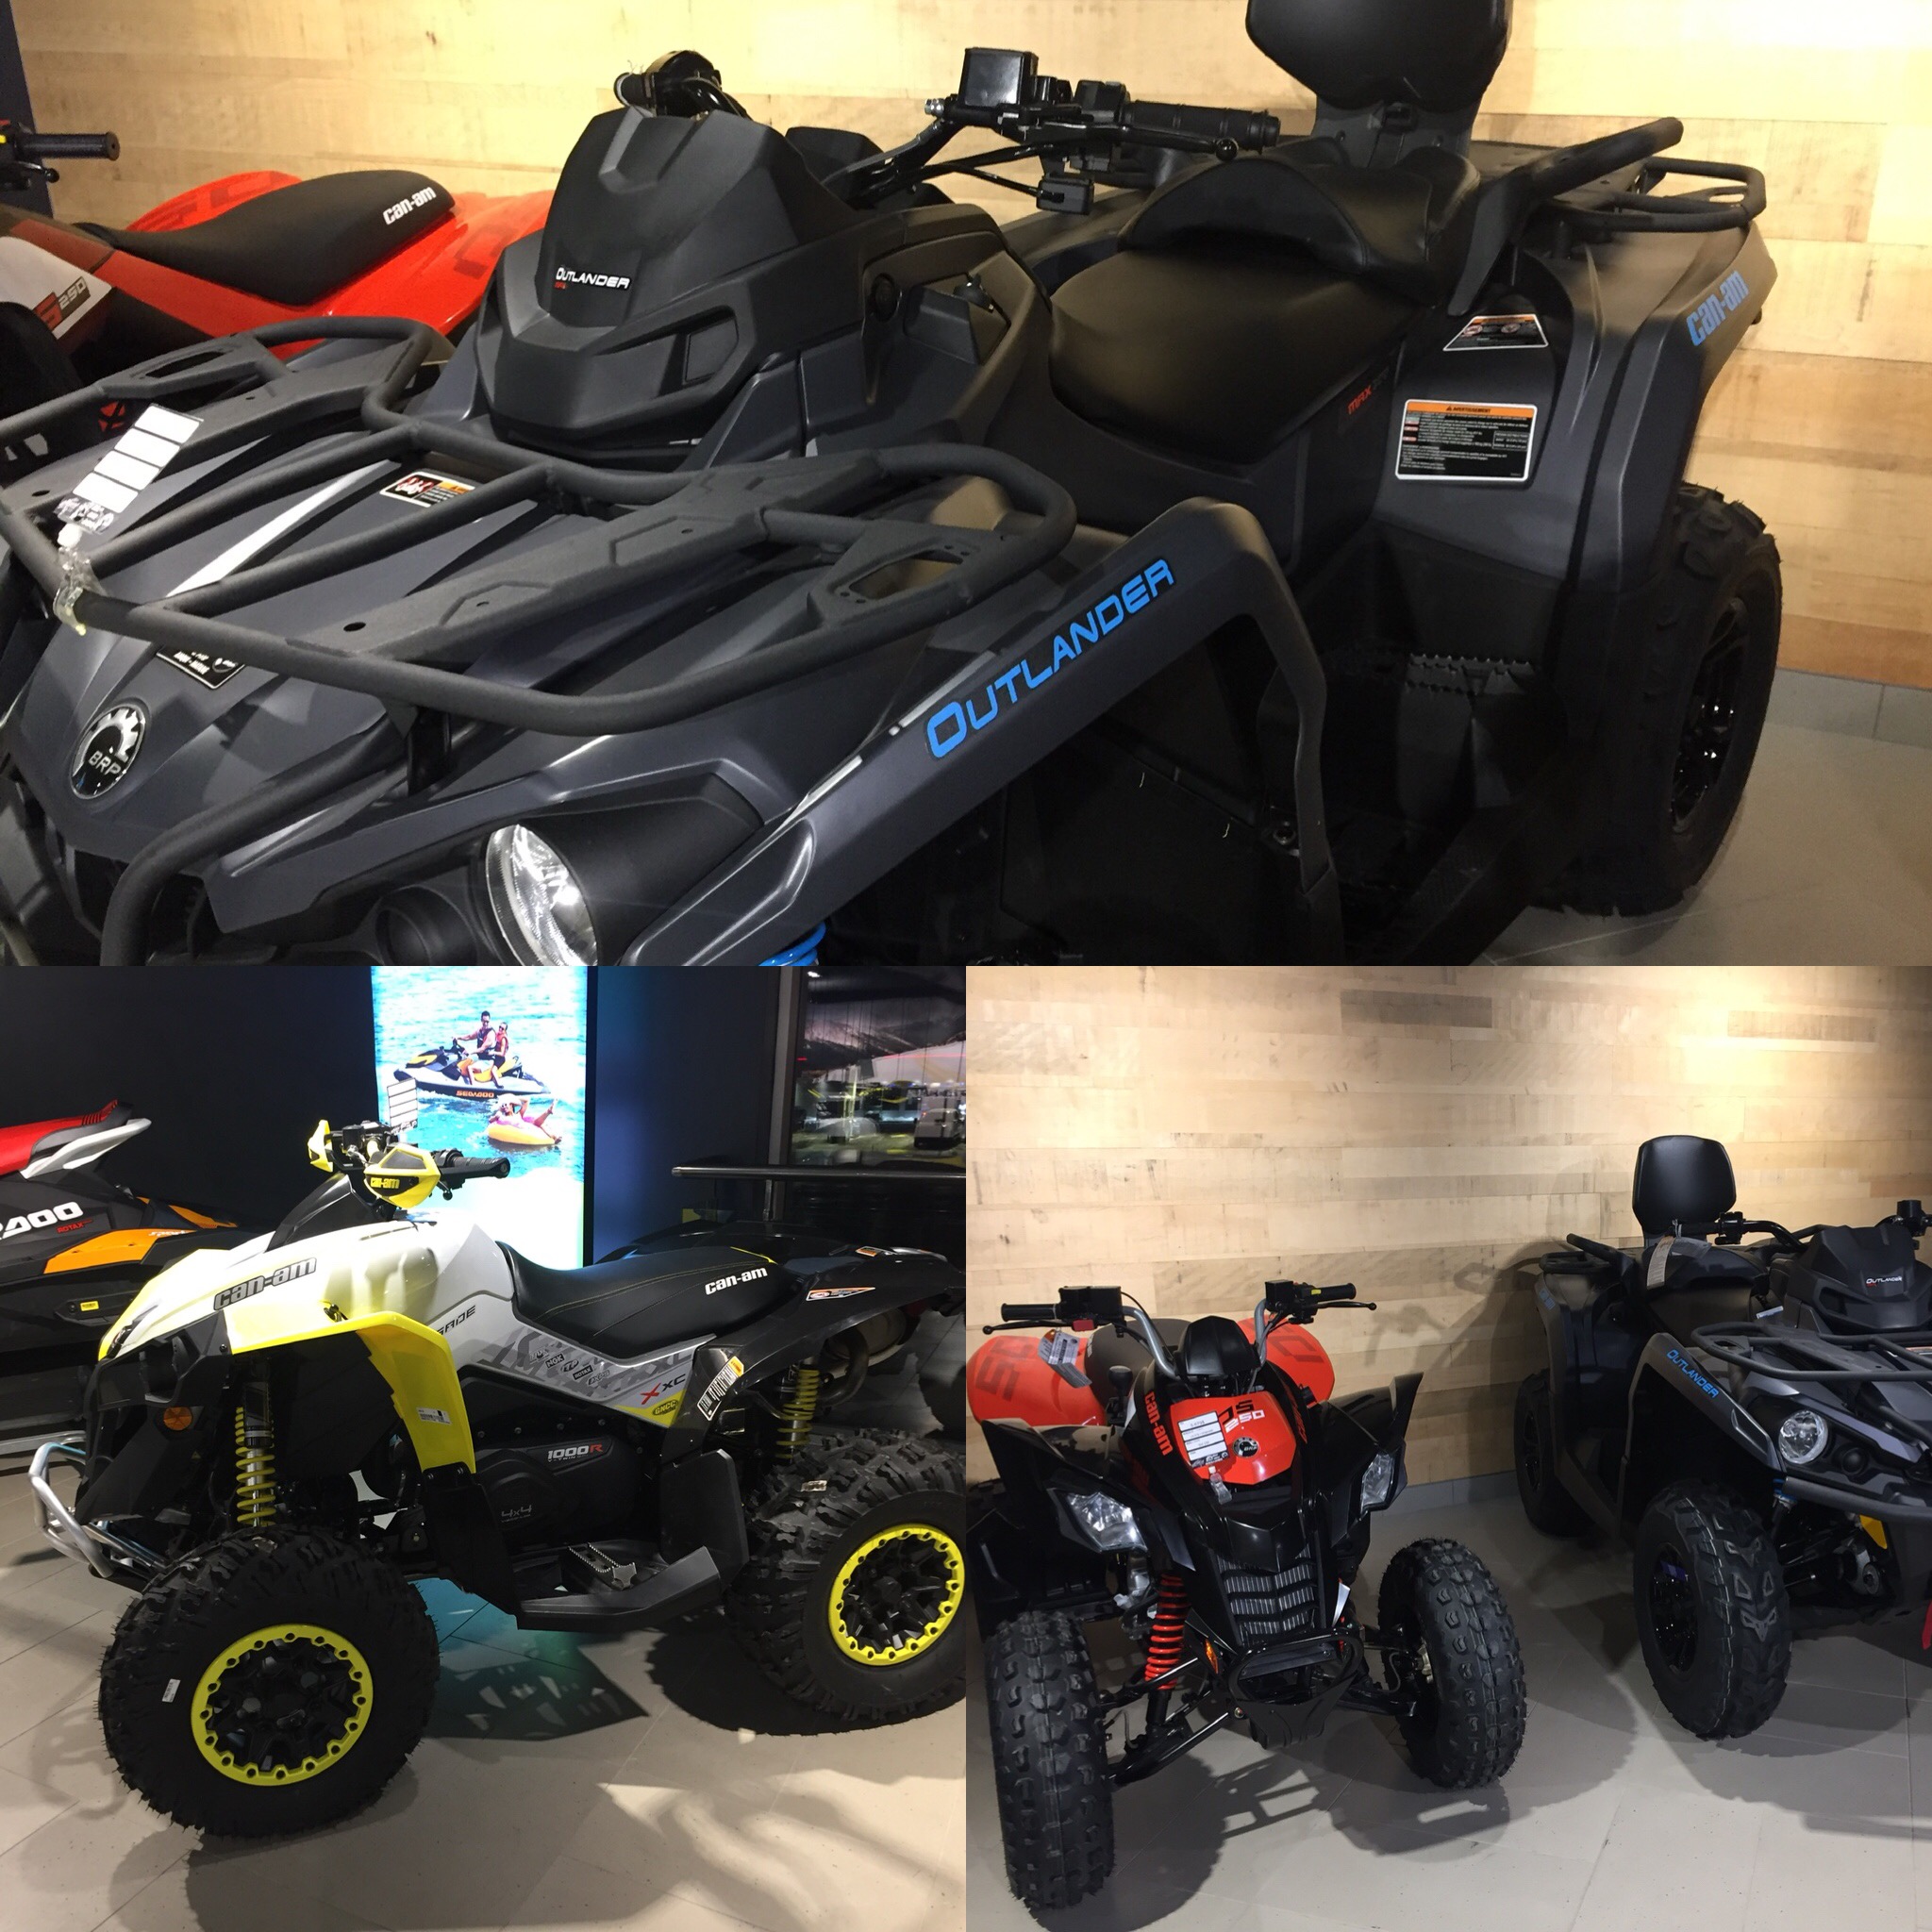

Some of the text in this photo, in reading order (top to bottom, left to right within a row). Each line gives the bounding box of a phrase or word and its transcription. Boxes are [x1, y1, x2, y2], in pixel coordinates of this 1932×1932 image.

[555, 266, 632, 291] OUTLANDER
[57, 275, 88, 311] 250
[926, 558, 1175, 758] OUTLANDER
[88, 750, 122, 776] BRP
[56, 1221, 85, 1233] ROTAX
[212, 1257, 318, 1311] can-am
[705, 1266, 769, 1296] can-am
[1865, 1275, 1903, 1285] OUTLANDER
[545, 1353, 565, 1369] NGK
[573, 1365, 593, 1380] ROTAX
[1666, 1348, 1720, 1399] OUTLANDER
[654, 1400, 677, 1415] GNCC
[1224, 1408, 1266, 1434] 250
[547, 1443, 604, 1460] 1000R
